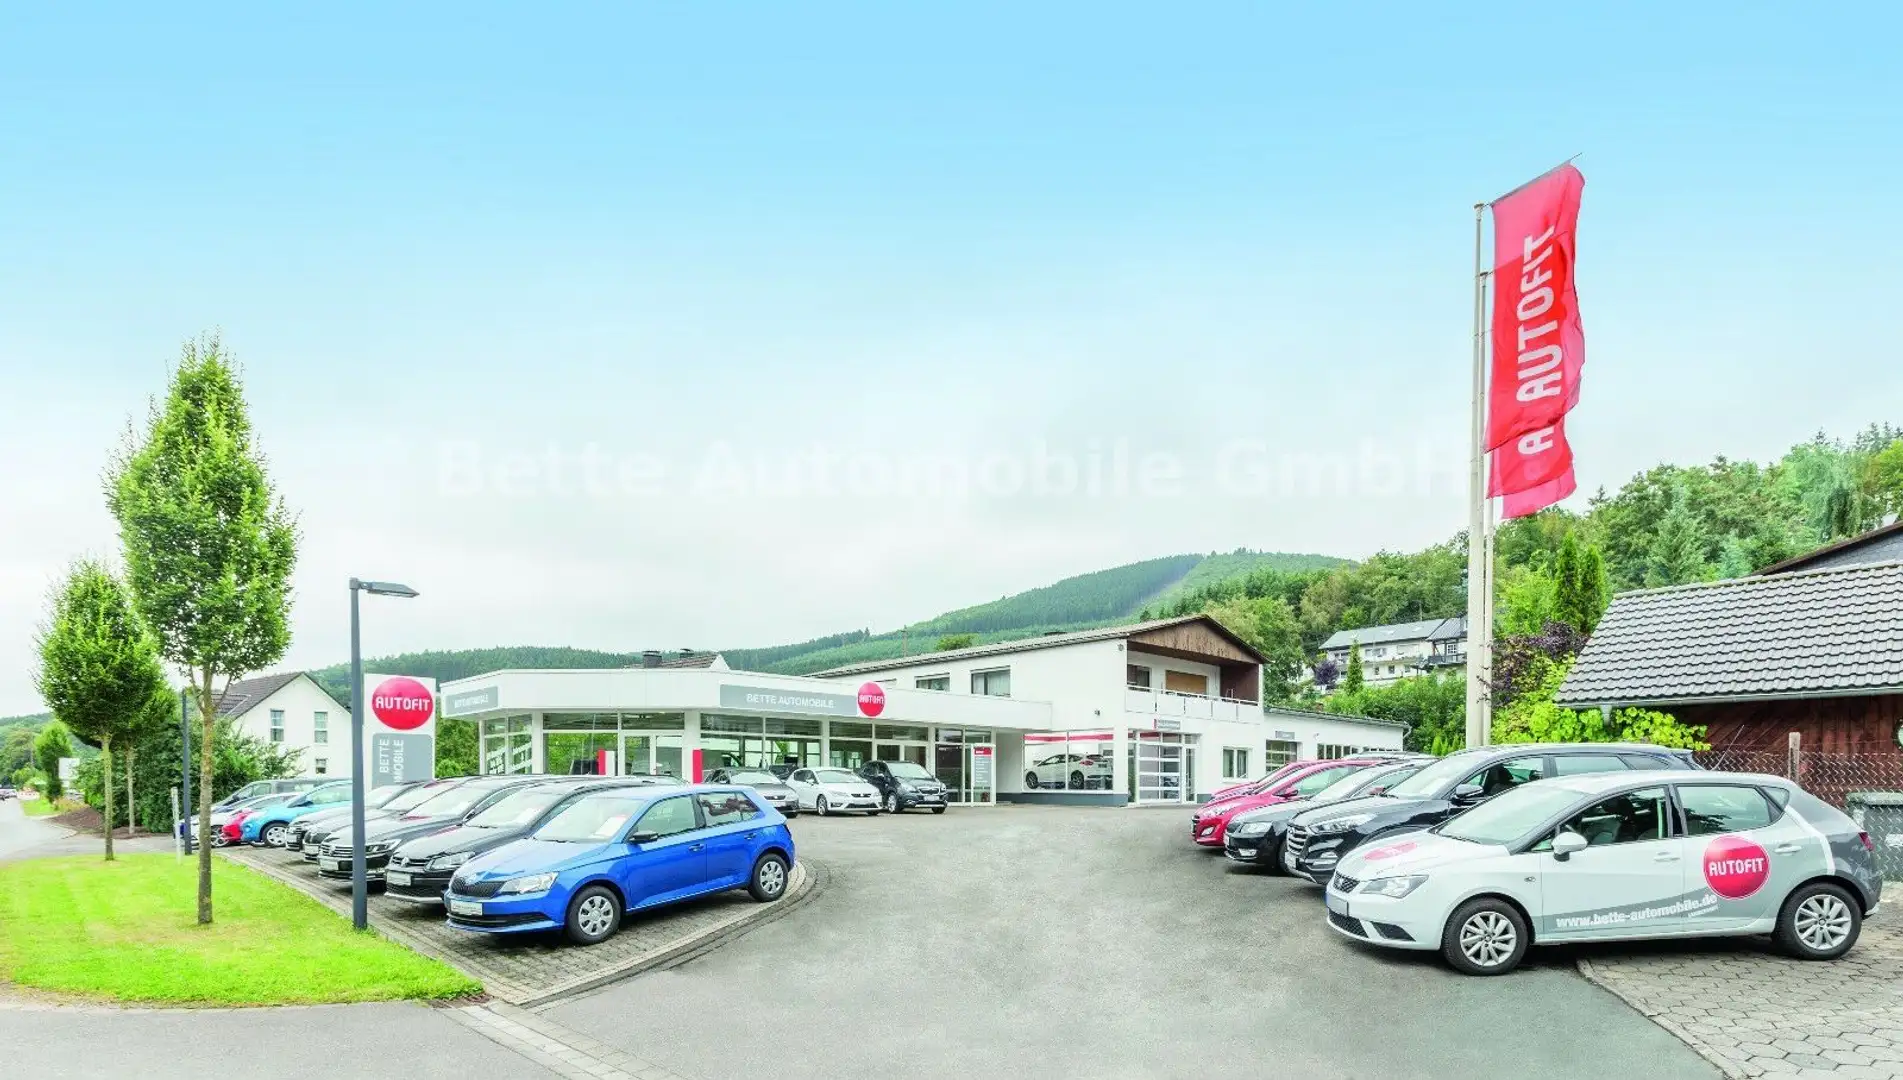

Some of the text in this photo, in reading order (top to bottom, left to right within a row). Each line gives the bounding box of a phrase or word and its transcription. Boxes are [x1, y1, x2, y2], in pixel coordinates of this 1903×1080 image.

[1516, 224, 1564, 403] AUTOFIT
[375, 696, 431, 711] AUTOFIT
[746, 693, 834, 709] BETTE AUTOMOBILE
[379, 738, 389, 773] BETTE
[1709, 857, 1765, 877] AUTOFIT
[1556, 893, 1718, 928] www.bette-automobile.de
